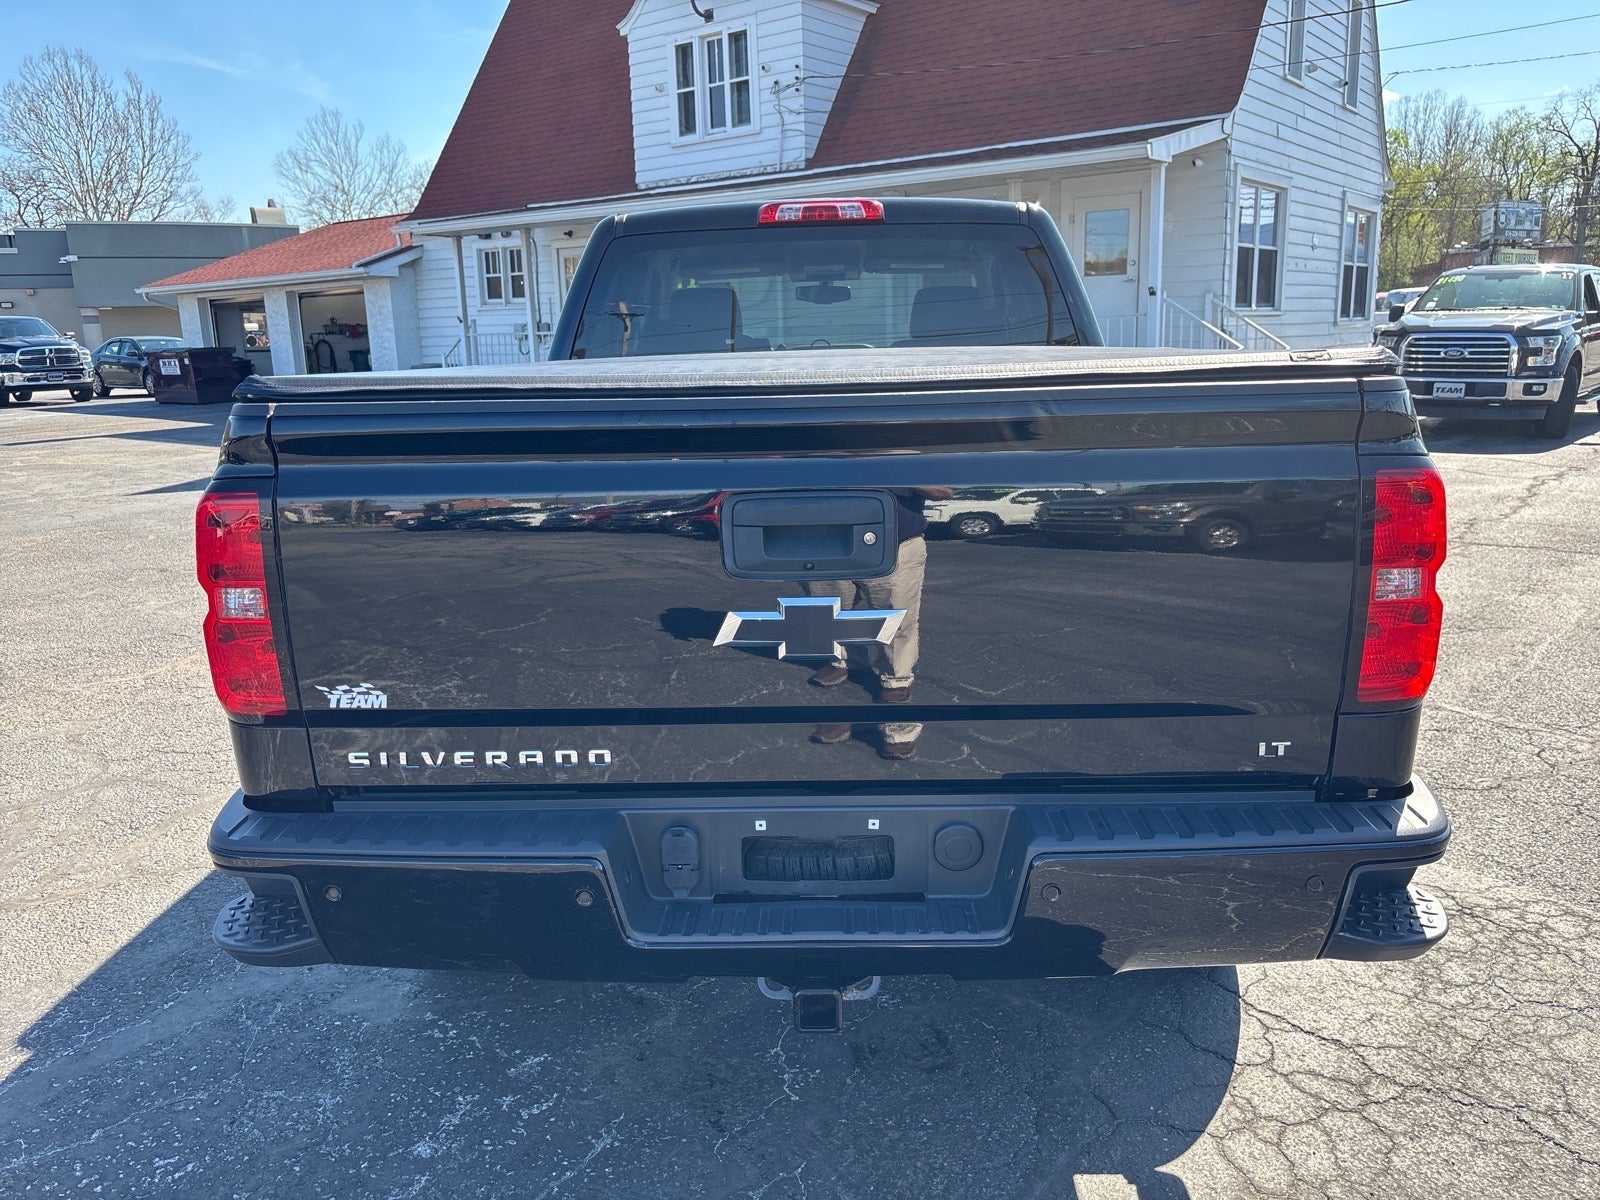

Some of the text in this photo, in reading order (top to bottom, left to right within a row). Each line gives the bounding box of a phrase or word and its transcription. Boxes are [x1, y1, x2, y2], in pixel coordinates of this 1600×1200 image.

[1561, 271, 1574, 280] 17
[327, 694, 388, 709] TEAM
[1258, 741, 1292, 758] LT
[348, 749, 613, 770] SILVERADO
